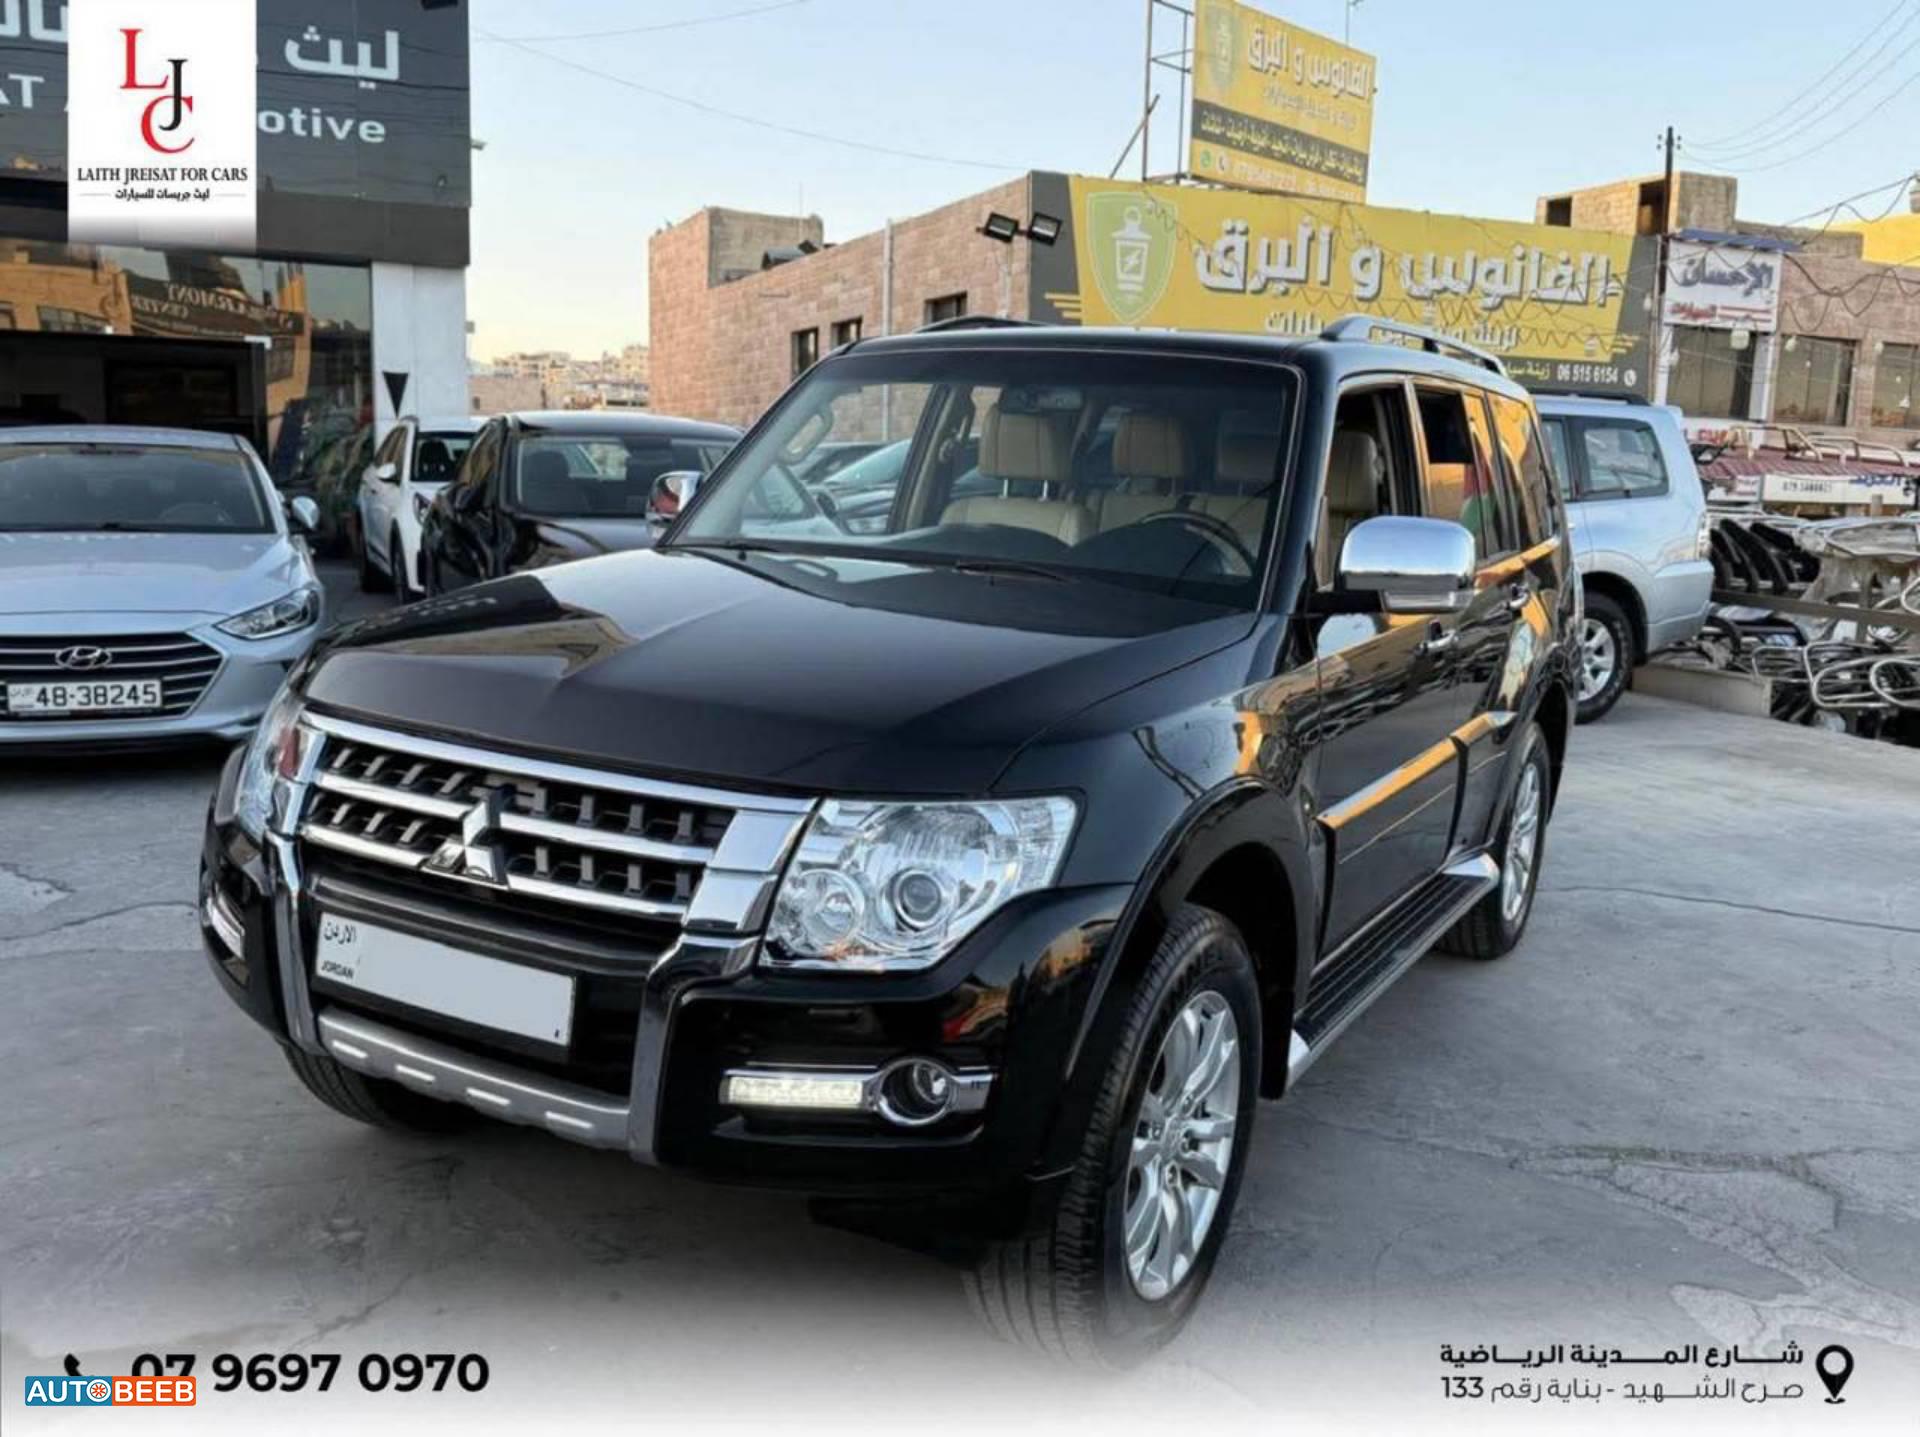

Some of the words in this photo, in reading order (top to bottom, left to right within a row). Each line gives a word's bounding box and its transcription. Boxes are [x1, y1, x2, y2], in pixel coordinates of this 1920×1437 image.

[285, 25, 399, 90] ليث
[257, 107, 386, 143] otive
[1195, 216, 1335, 297] البرق
[1351, 244, 1384, 300] و
[1400, 243, 1612, 311] الفانوس
[321, 959, 354, 980] JORDAN
